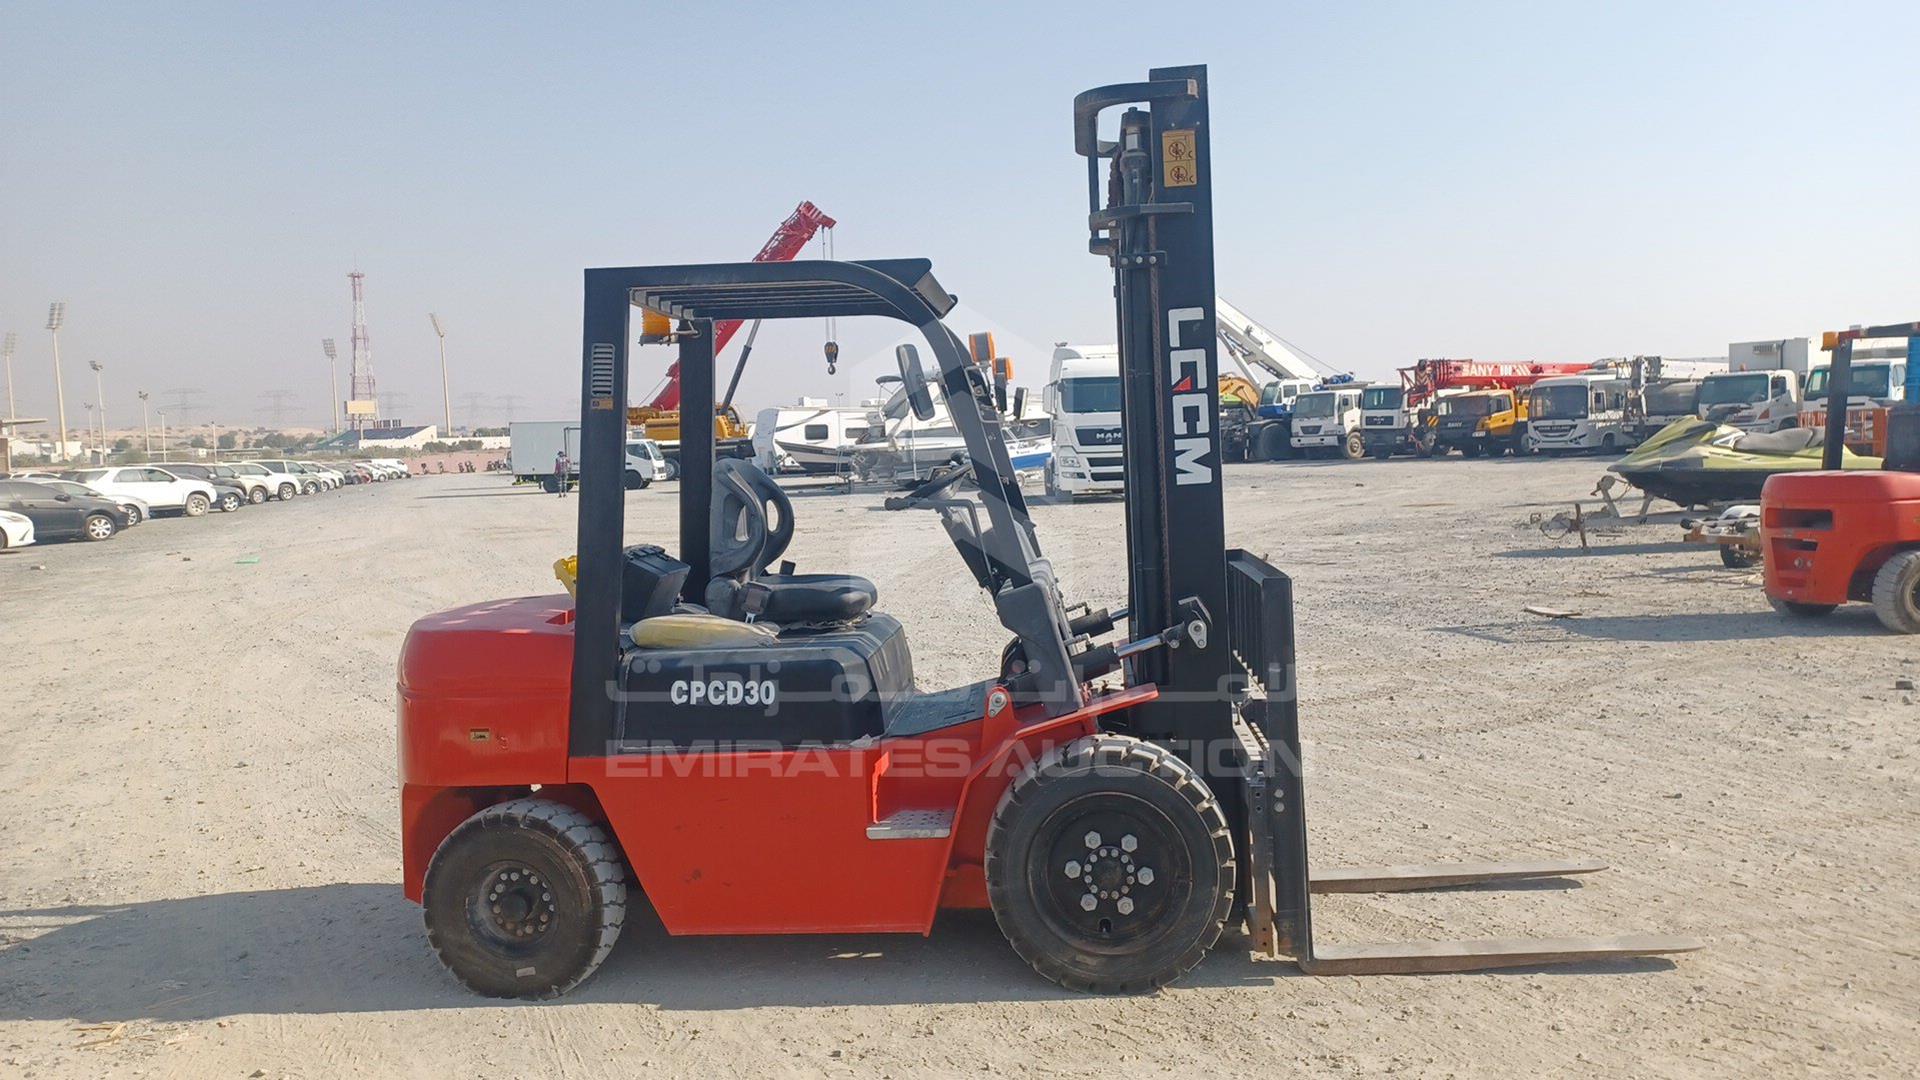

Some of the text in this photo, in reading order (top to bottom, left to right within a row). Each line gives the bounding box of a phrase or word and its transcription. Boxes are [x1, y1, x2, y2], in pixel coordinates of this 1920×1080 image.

[1462, 363, 1495, 377] SANY
[1096, 432, 1122, 440] MAN
[670, 680, 776, 706] CPCD30
